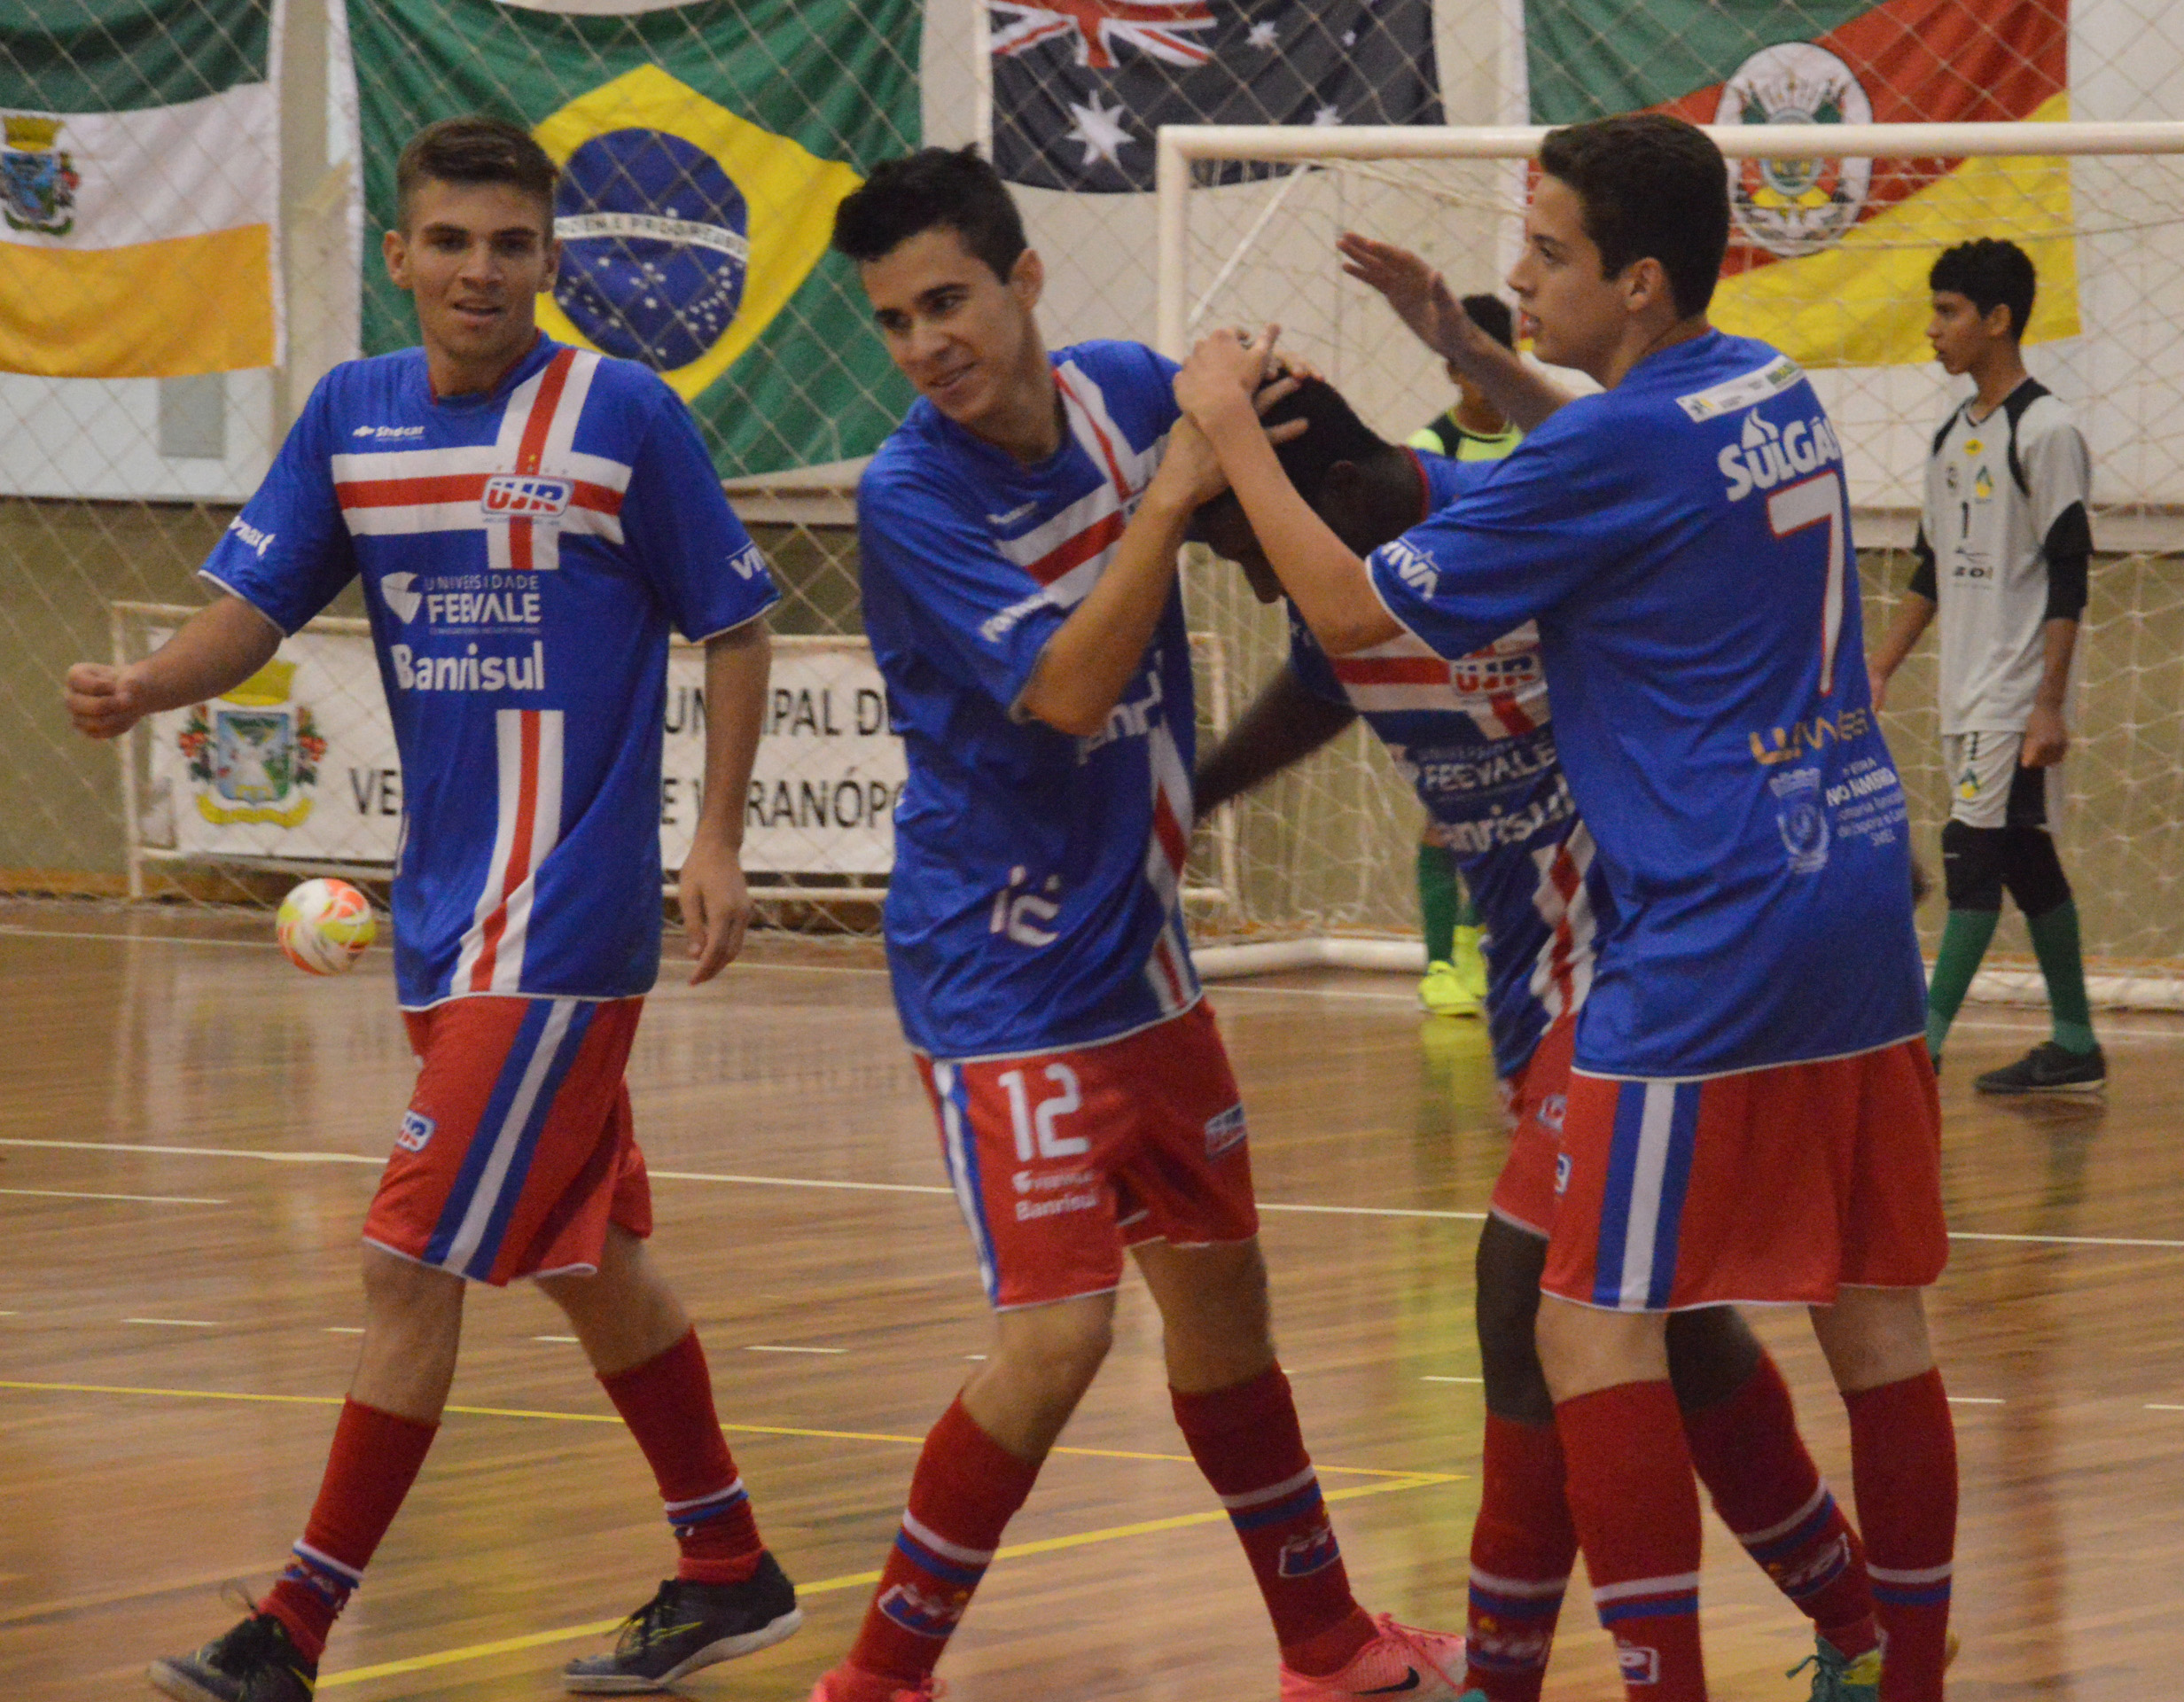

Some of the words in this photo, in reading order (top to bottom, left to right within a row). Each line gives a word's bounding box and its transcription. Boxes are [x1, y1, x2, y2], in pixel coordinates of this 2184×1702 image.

[1717, 417, 1842, 502] SULGÁ
[729, 546, 766, 580] VI
[1766, 469, 1845, 699] 7
[391, 640, 545, 691] Banrisul
[998, 1062, 1091, 1162] 12
